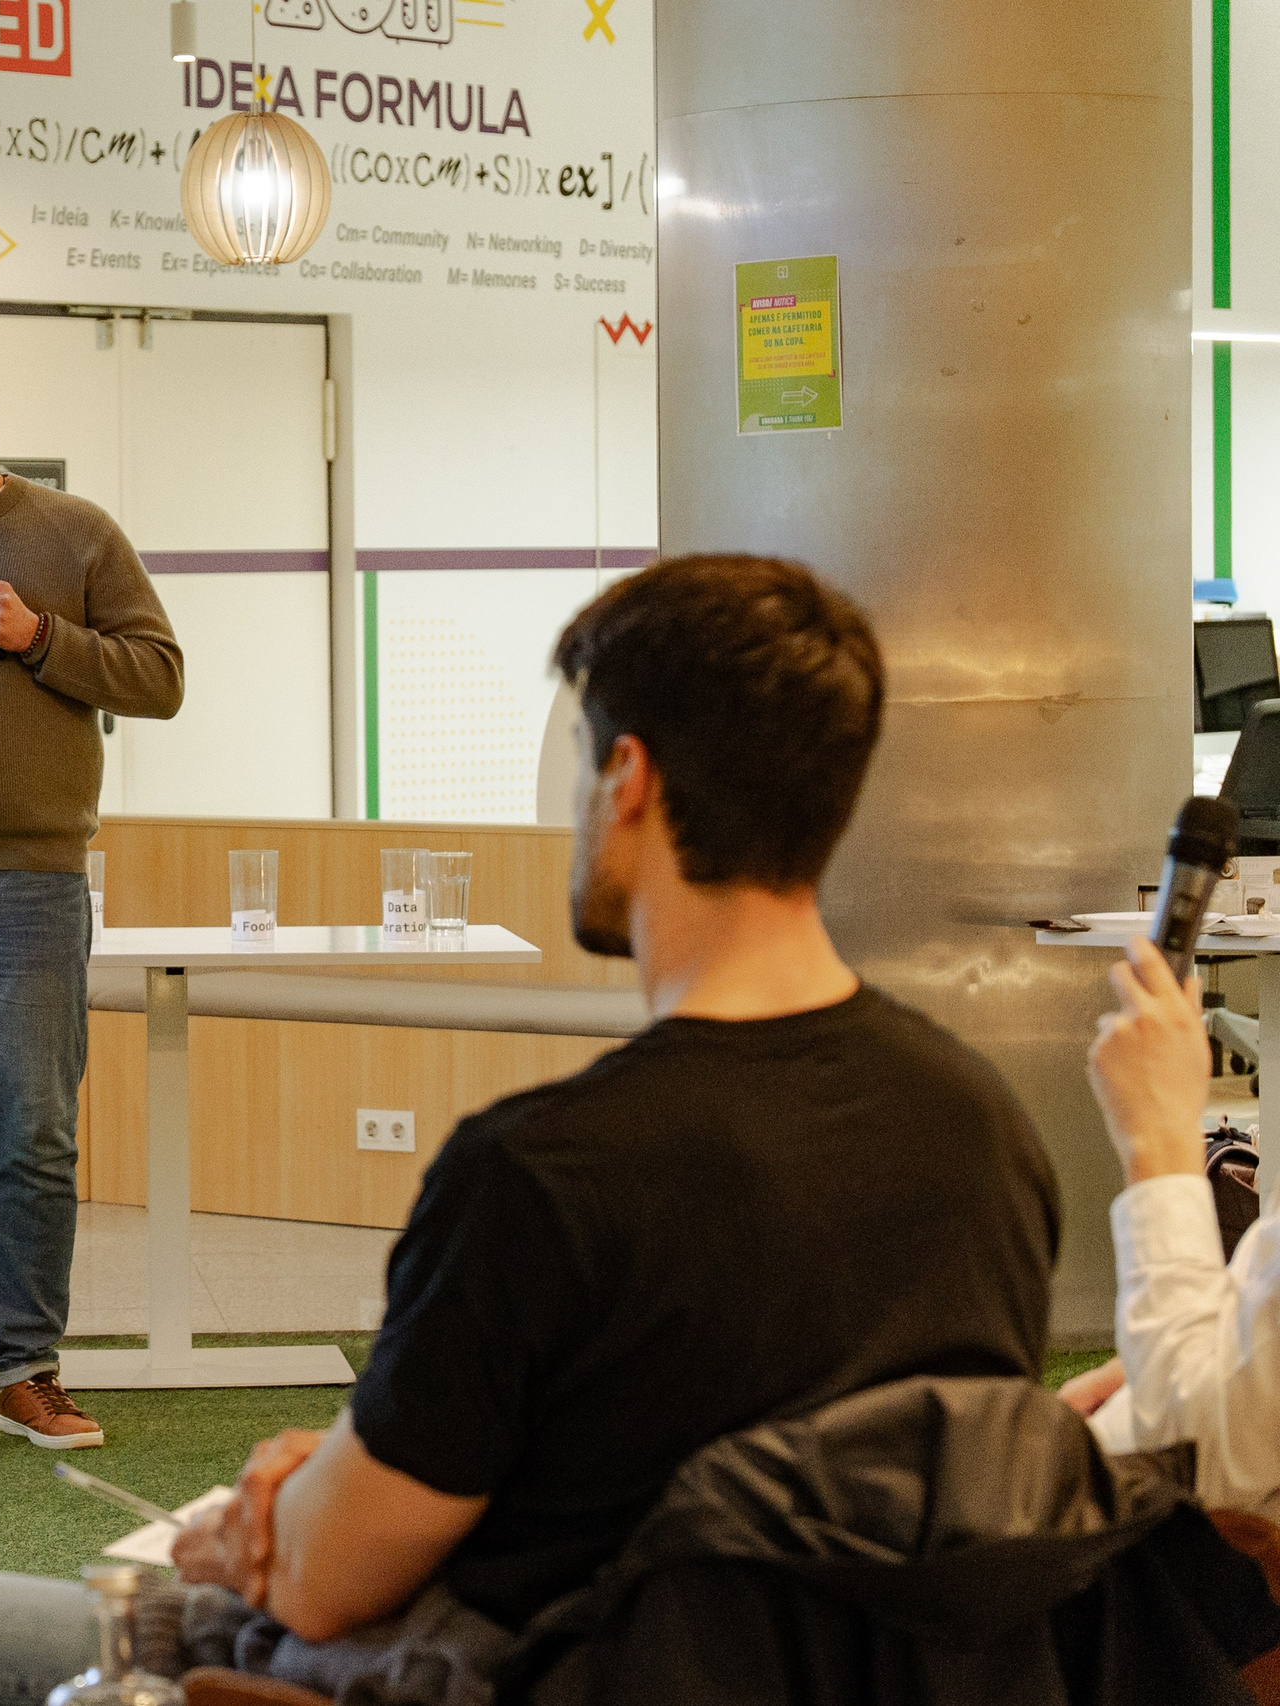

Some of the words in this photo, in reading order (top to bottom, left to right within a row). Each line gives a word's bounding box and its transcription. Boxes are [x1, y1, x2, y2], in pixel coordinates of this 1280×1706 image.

[315, 69, 531, 137] FORMULA
[51, 205, 88, 227] Ideia
[135, 210, 188, 232] Knowle
[372, 225, 449, 251] Community
[488, 232, 562, 258] Networking
[599, 239, 652, 263] Diversity
[90, 248, 141, 269] Events
[330, 260, 422, 283] Collaboration
[574, 273, 626, 293] Success
[749, 313, 775, 323] APENAS
[782, 310, 822, 321] PERMITIDO
[783, 323, 822, 334] CAFETARIA
[388, 902, 417, 913] Data
